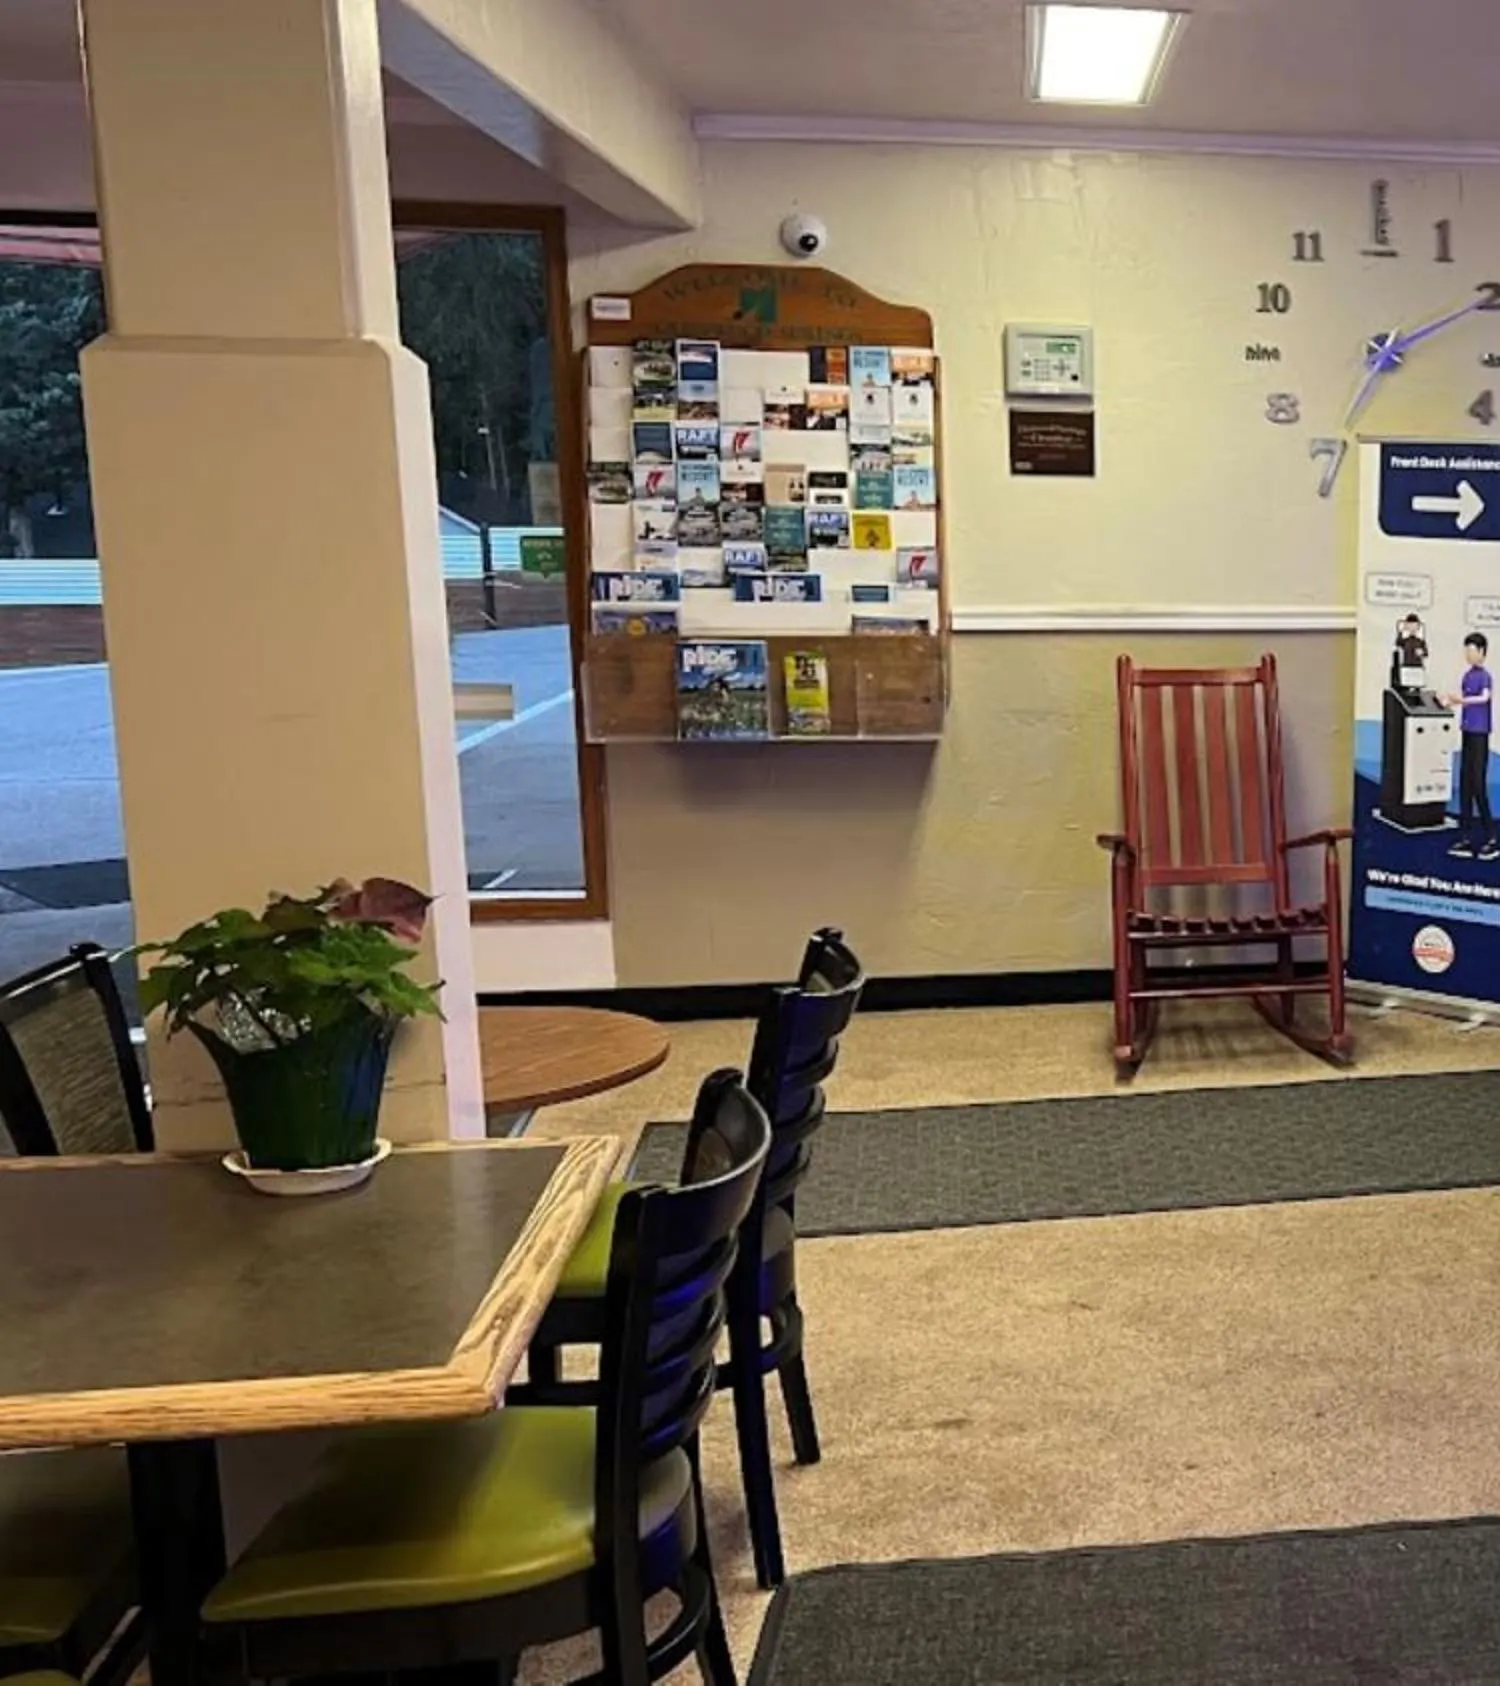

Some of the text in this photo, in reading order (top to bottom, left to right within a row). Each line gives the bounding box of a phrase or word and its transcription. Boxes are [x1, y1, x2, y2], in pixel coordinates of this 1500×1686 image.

[1292, 231, 1325, 262] 11
[1433, 219, 1454, 263] 1
[1256, 282, 1291, 313] 10
[1265, 393, 1300, 425] 8
[1468, 389, 1496, 426] 4
[1310, 437, 1347, 498] 7
